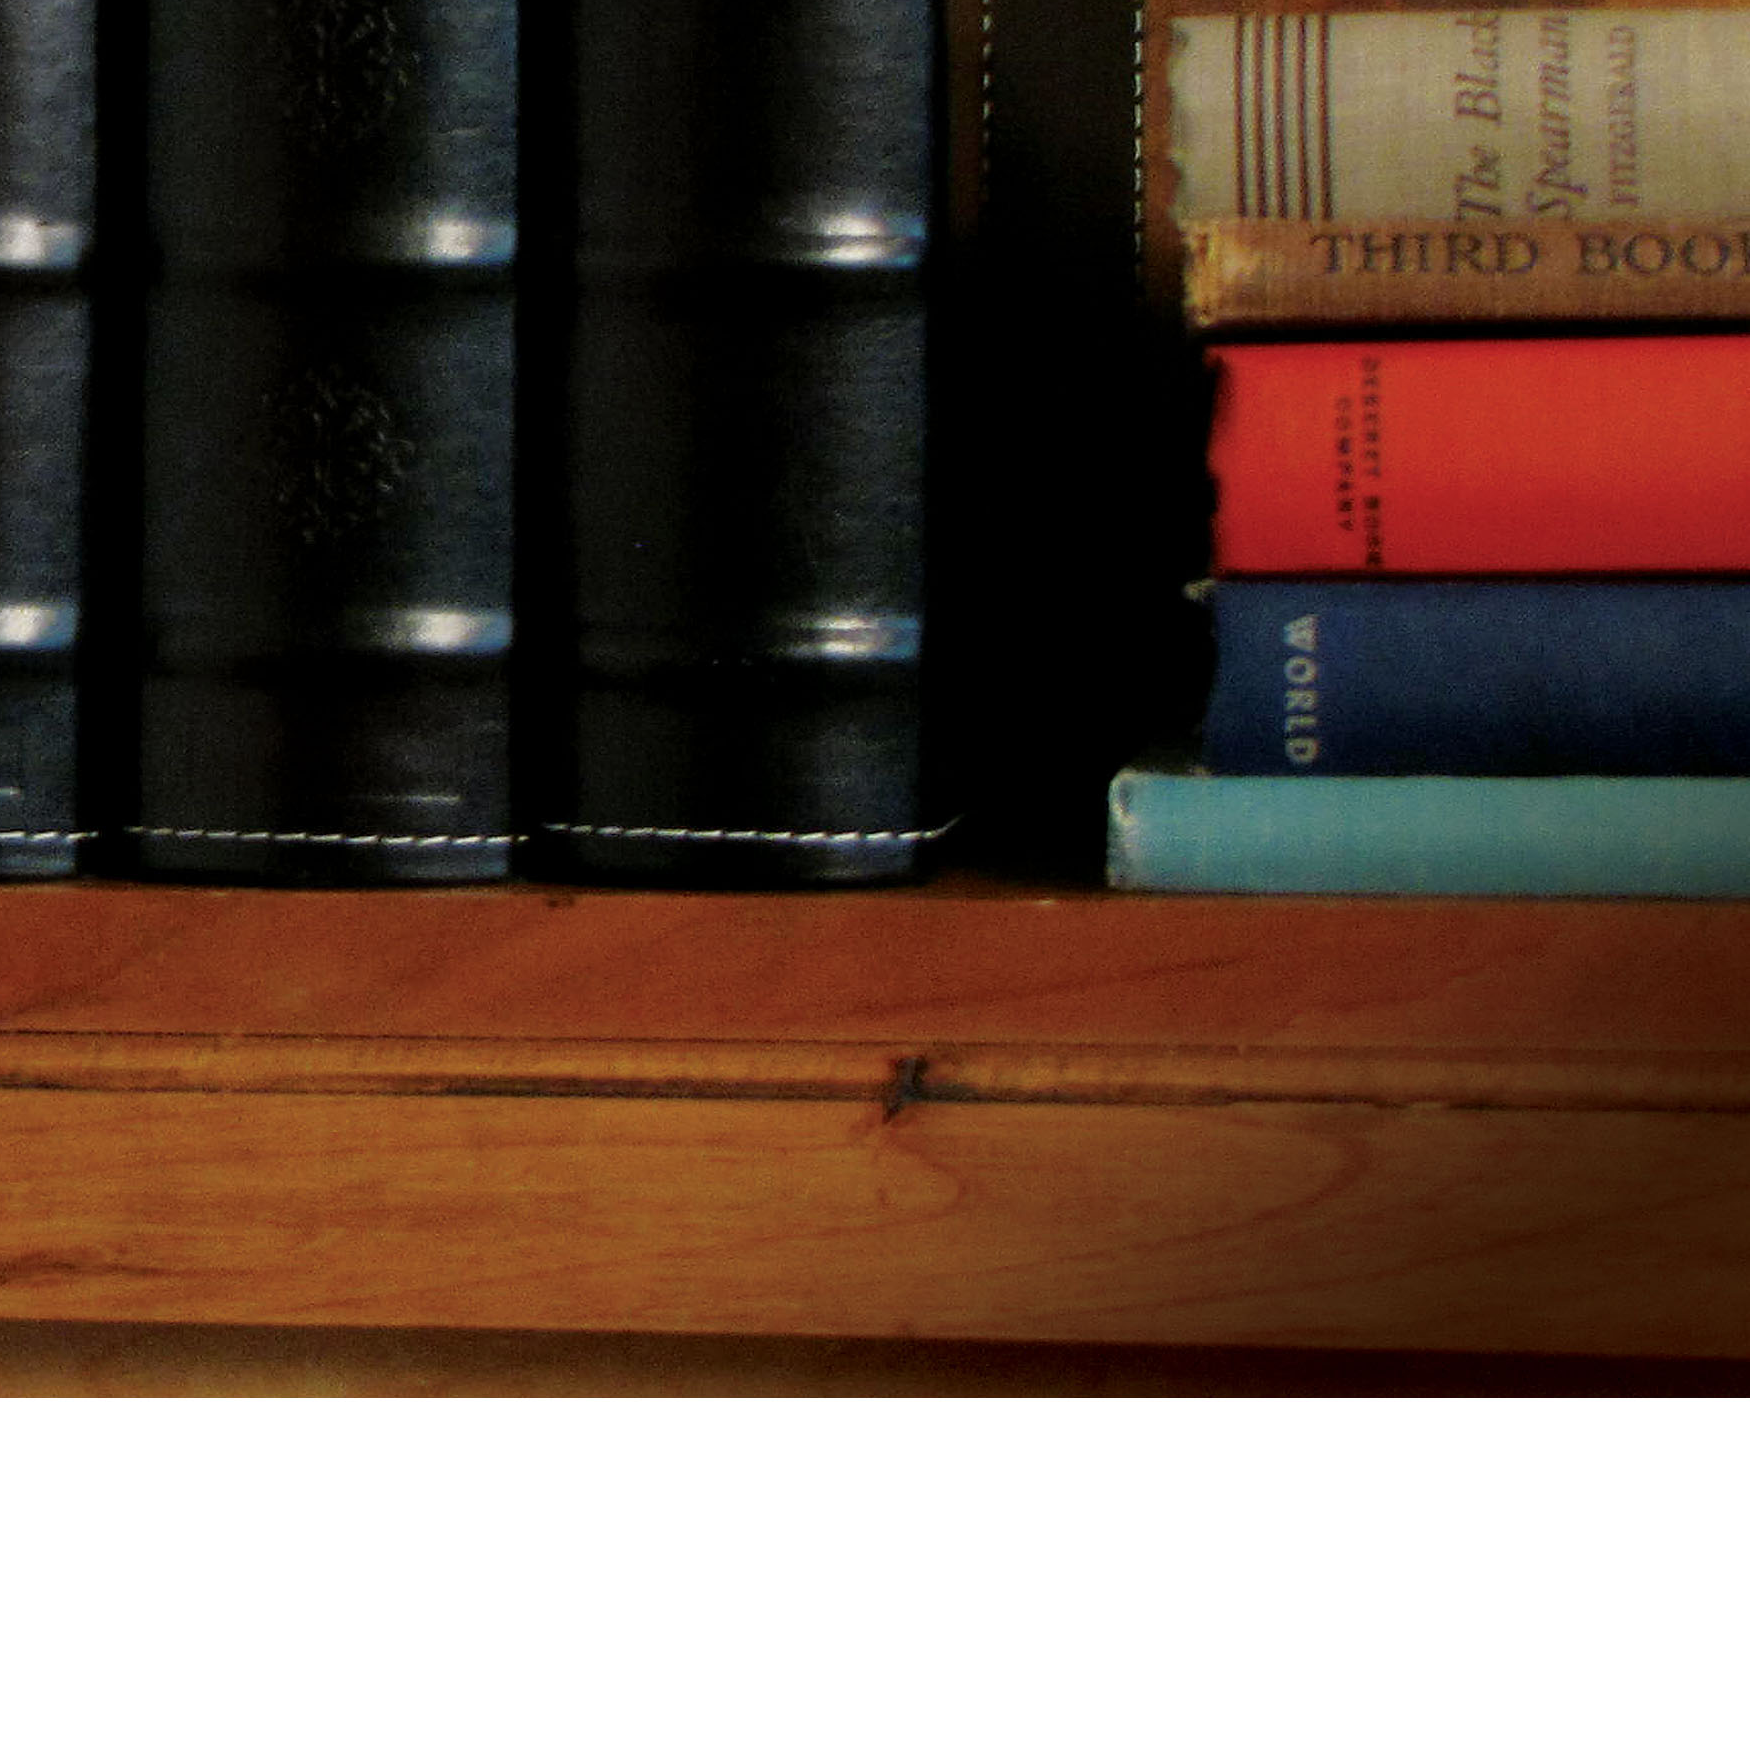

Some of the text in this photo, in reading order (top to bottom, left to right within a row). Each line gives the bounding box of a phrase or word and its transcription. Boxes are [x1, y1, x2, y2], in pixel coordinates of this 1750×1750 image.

[1453, 144, 1502, 221] The
[1527, 14, 1588, 221] Spearman
[1608, 25, 1640, 208] FITZGERALD
[1310, 231, 1539, 276] THIRD
[1335, 396, 1355, 532] COMPANY
[1283, 613, 1319, 765] WORLD
